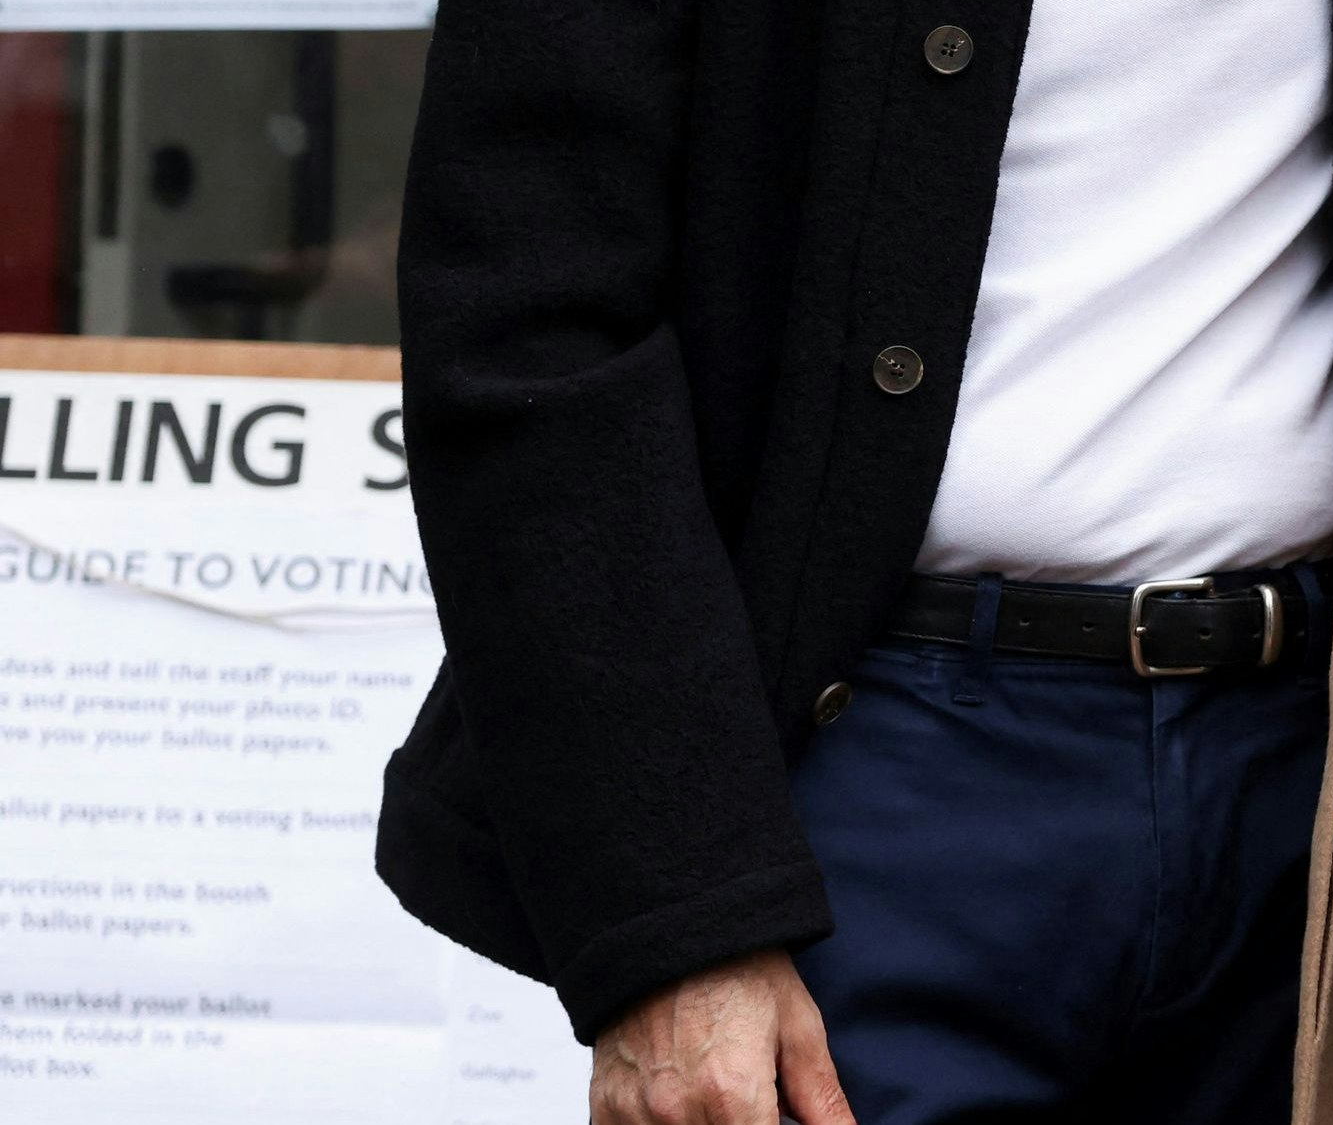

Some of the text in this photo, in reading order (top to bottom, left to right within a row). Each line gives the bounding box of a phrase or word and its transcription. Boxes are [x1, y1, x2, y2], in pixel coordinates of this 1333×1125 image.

[163, 551, 232, 589] TO
[66, 660, 110, 678] and
[168, 661, 207, 682] the
[280, 669, 337, 692] your
[20, 691, 65, 710] and
[178, 699, 236, 721] your
